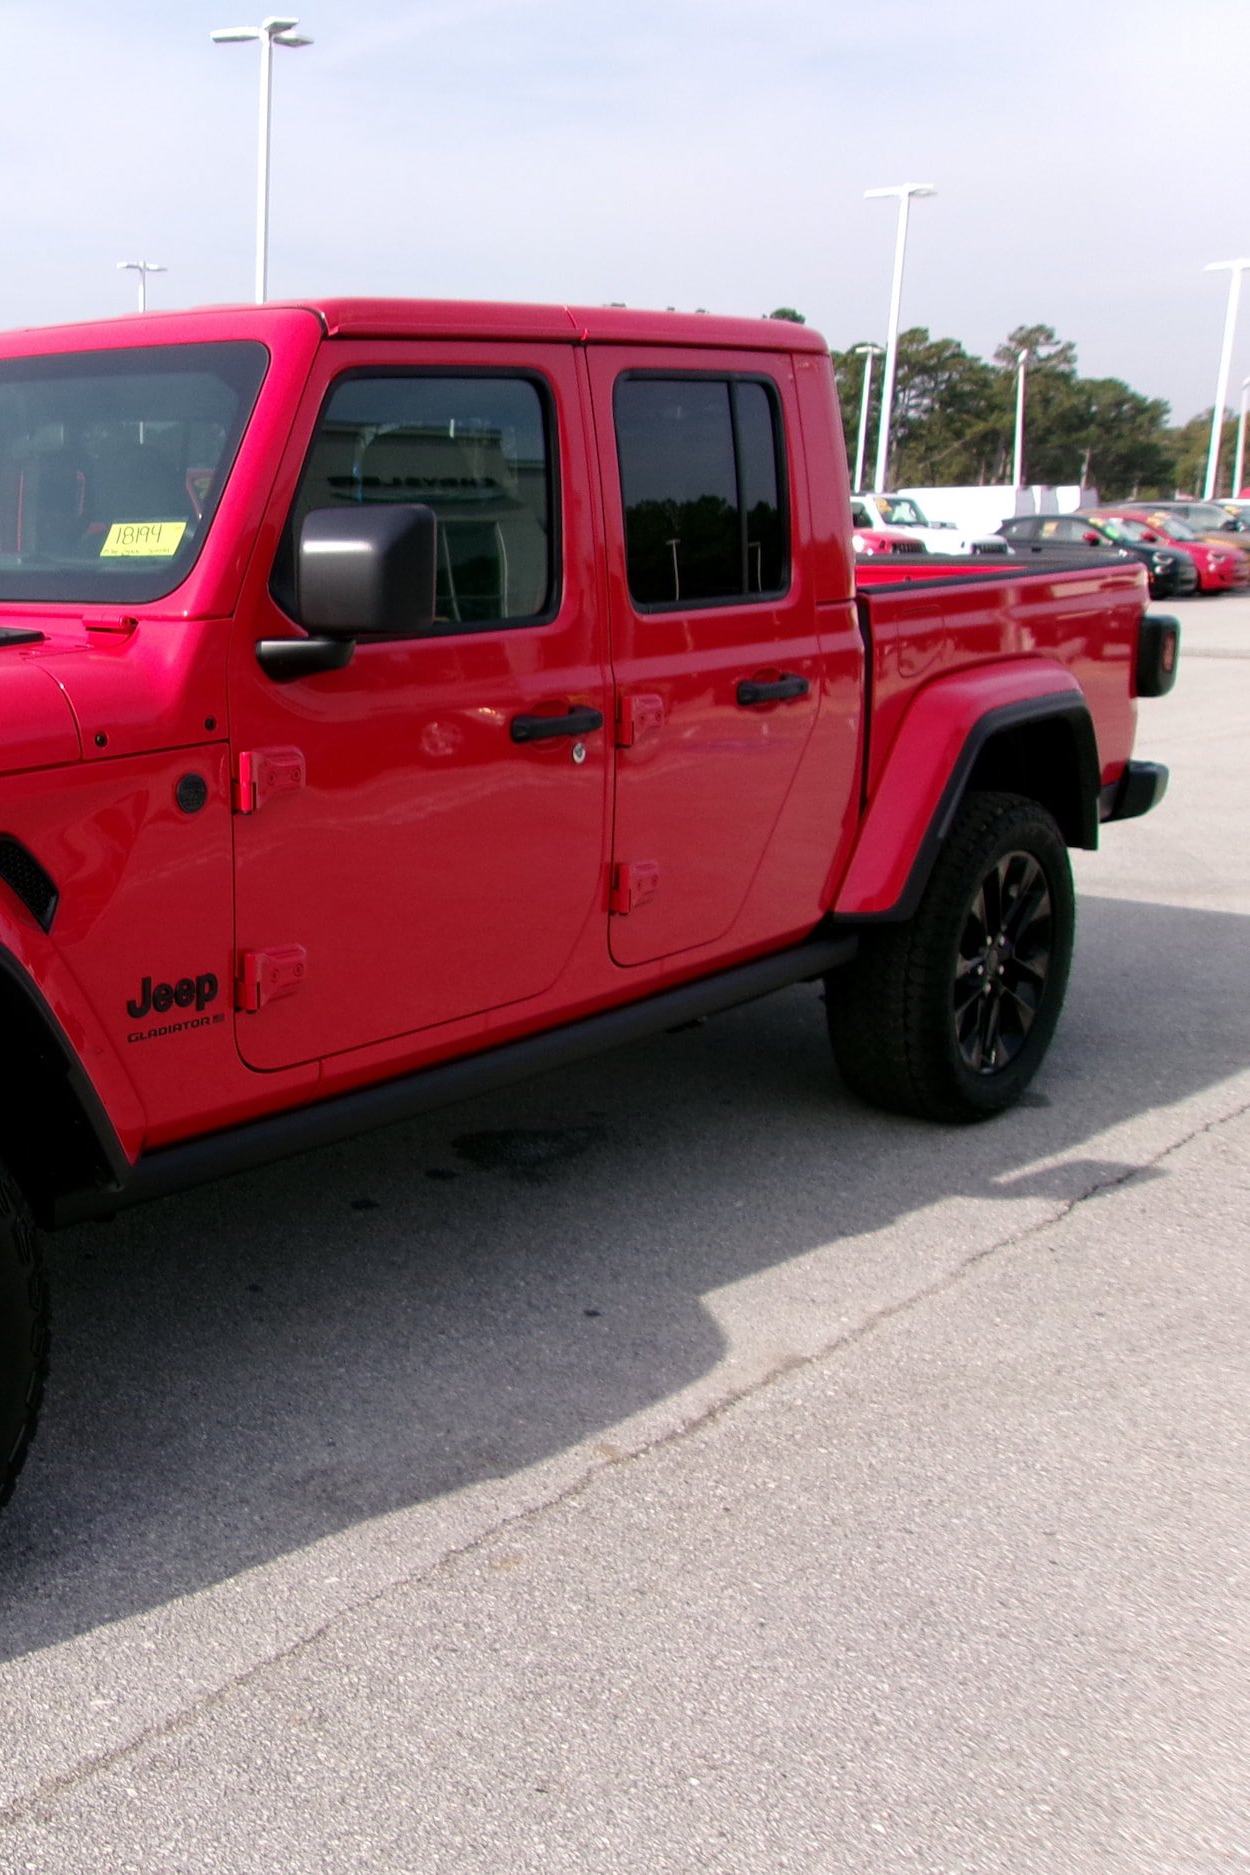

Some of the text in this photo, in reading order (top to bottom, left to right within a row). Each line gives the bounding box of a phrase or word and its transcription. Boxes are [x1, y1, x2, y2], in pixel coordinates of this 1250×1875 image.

[116, 524, 162, 545] 18194
[126, 973, 218, 1018] Jeep
[127, 1017, 210, 1043] GLADIATOR
